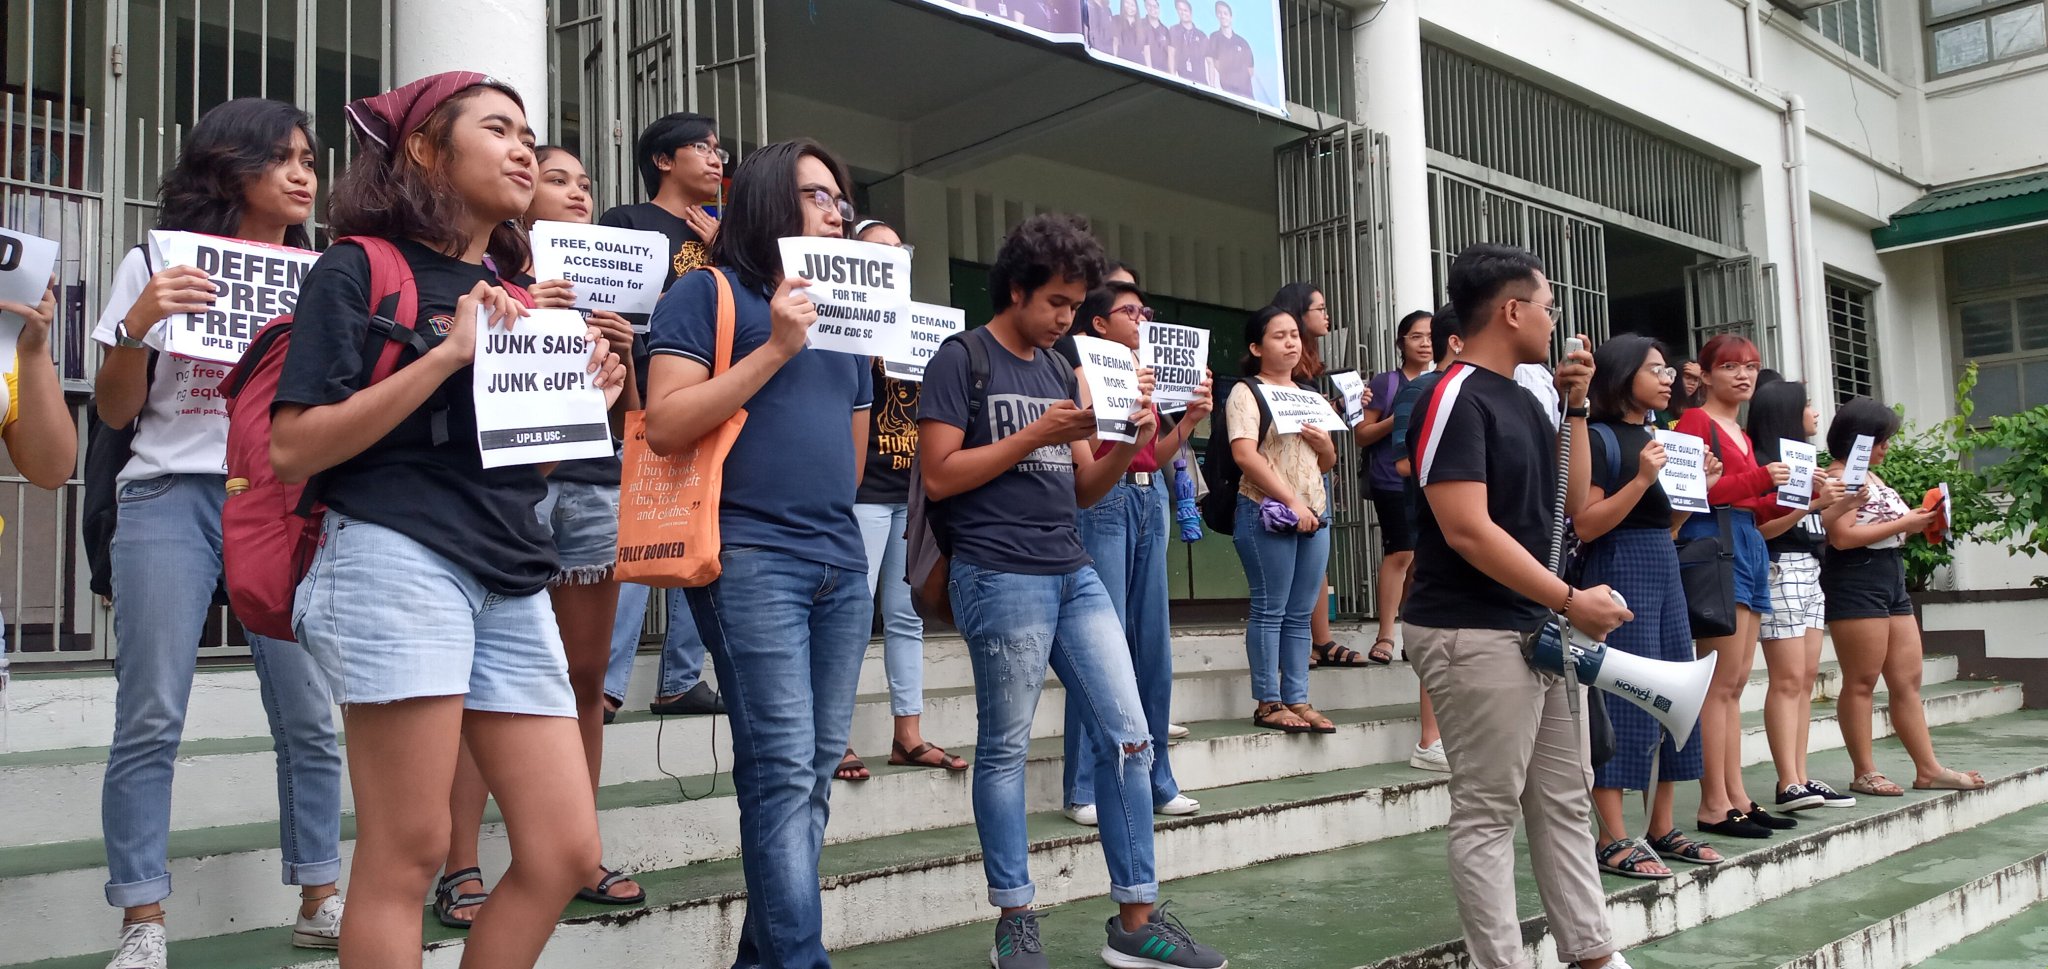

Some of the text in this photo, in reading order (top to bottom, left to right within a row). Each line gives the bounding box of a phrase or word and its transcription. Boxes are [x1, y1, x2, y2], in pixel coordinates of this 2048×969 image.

[551, 238, 653, 259] FREE, QUALITY,
[196, 245, 310, 288] DEFEN
[563, 256, 643, 273] ACCESSIBLE
[798, 253, 895, 290] JUSTICE
[563, 272, 644, 290] Education for
[206, 279, 298, 315] PRES
[589, 292, 616, 304] ALL!
[832, 288, 867, 303] FOR THE
[813, 303, 896, 324] GUINDANAO 58
[187, 309, 270, 340] FREE
[911, 314, 957, 330] DEMAND
[818, 323, 873, 339] UPLB CDC SC
[911, 330, 940, 344] MORE
[1148, 325, 1200, 349] DEFEND
[202, 337, 234, 350] UPLB
[485, 334, 588, 354] JUNK SAIS!
[1088, 352, 1134, 372] WE DEMAND
[1153, 346, 1196, 367] PRESS
[193, 364, 225, 379] free
[488, 372, 585, 393] JUNK eUP!
[1103, 376, 1128, 390] MORE
[190, 388, 228, 401] equ
[1271, 391, 1320, 405] JUSTICE
[516, 432, 542, 443] UPLB
[543, 431, 561, 442] USC
[643, 464, 666, 480] buy
[1665, 469, 1689, 479] Education
[636, 508, 657, 520] and
[618, 541, 686, 563] FULLY BOOKED
